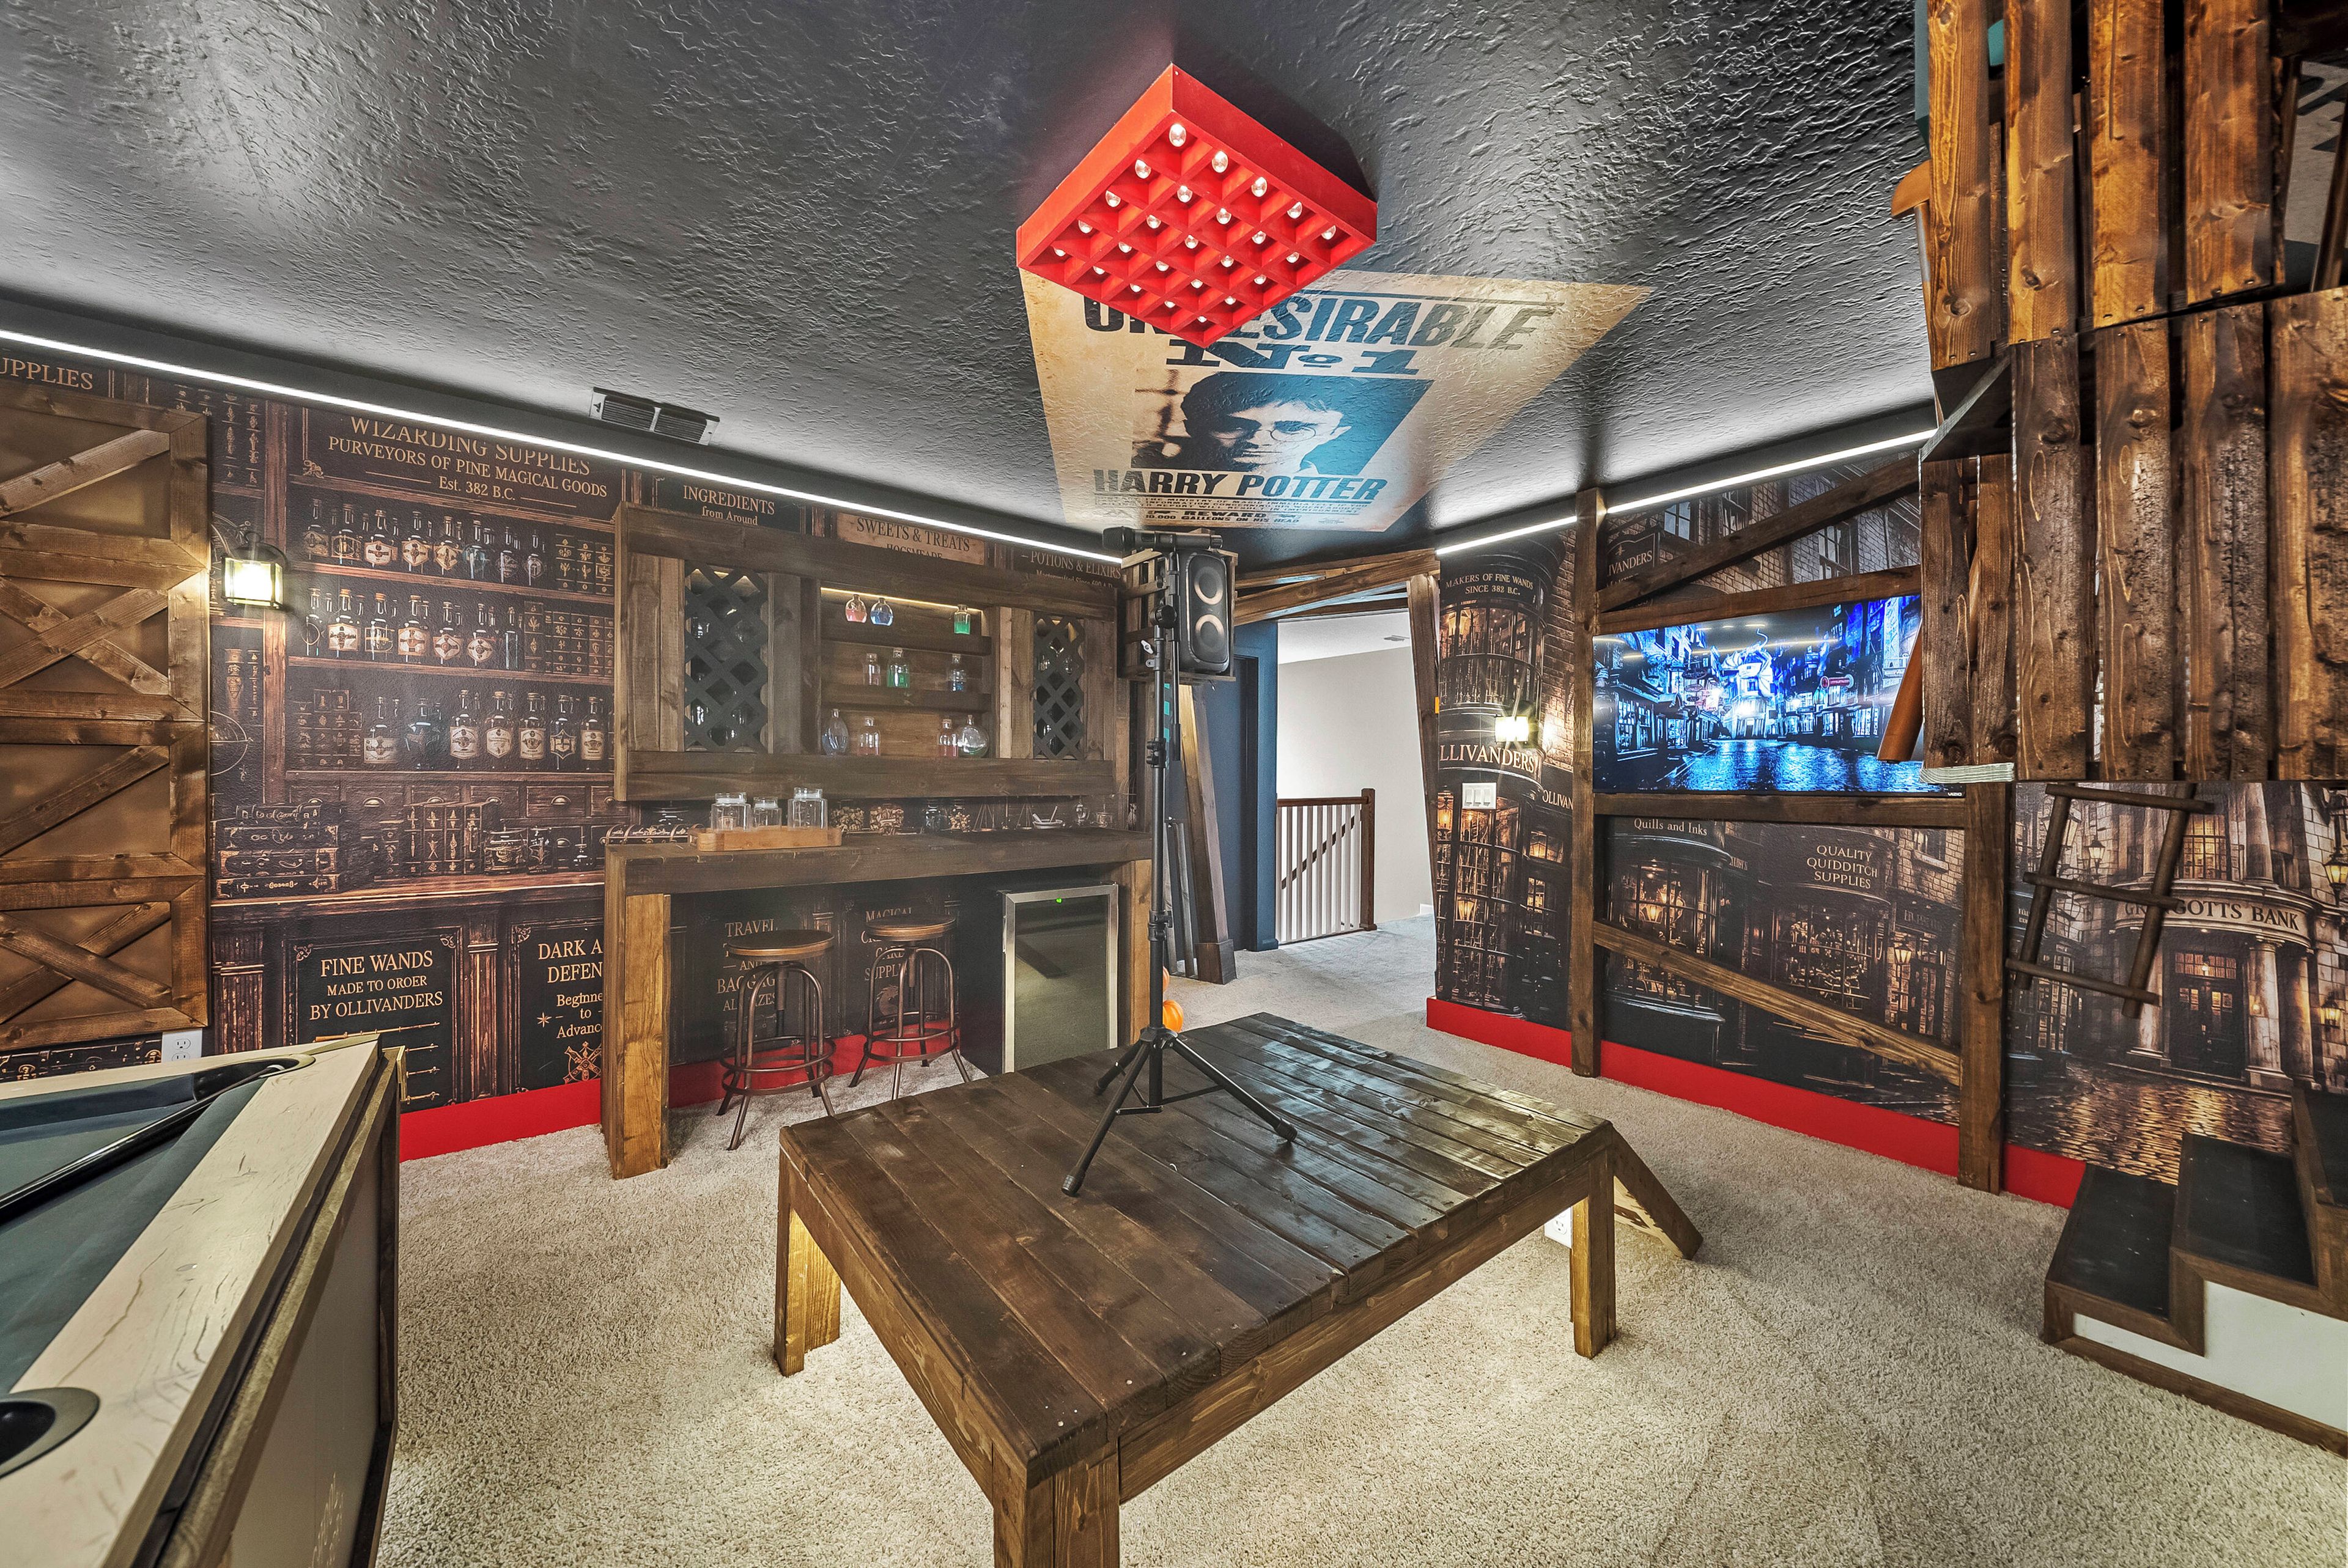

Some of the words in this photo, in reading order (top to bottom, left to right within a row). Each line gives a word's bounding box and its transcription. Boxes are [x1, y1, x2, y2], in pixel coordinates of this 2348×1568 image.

[1084, 295, 1556, 351] USIRABLE
[1351, 350, 1419, 375] 1
[351, 416, 487, 456] WIZARDING
[495, 444, 591, 476] SUPPLIES
[328, 436, 426, 466] PURVEYORS
[431, 455, 451, 470] OF
[495, 466, 558, 490] MAGICAL
[562, 479, 607, 498] GOODS
[439, 476, 461, 491] Est.
[466, 481, 489, 496] 382
[493, 486, 515, 501] B.C.
[1093, 469, 1228, 495] HARRY
[1236, 474, 1387, 500] POTTER
[683, 485, 775, 515] INGREDIENTS
[702, 506, 723, 520] from
[726, 510, 758, 526] Around
[857, 517, 909, 540] SWEETS
[913, 528, 921, 543] &
[925, 530, 970, 551] TREATS
[1030, 551, 1074, 570] POTIONS
[1076, 561, 1084, 572] &
[1086, 563, 1121, 579] ELIXIRS
[1445, 574, 1480, 588] MAKERS
[1495, 573, 1510, 583] FINE
[1512, 576, 1534, 590] WANDS
[1465, 585, 1489, 594] SINCE
[1508, 587, 1521, 595] B.C.
[1634, 818, 1664, 830] Quills
[1667, 822, 1685, 832] and
[1688, 822, 1707, 836] Inks
[1817, 845, 1872, 862] QUALITY
[1807, 857, 1878, 878] QUIDDITCH
[1814, 871, 1871, 889] SUPPLIES
[2125, 900, 2242, 919] GRGOTTS
[2251, 905, 2299, 930] BANK
[725, 919, 778, 937] TRAVEL
[538, 940, 586, 960] DARK
[321, 956, 365, 977] FINE
[369, 950, 433, 972] WANDS
[327, 982, 363, 996] MADE
[367, 980, 383, 992] TO
[309, 1004, 331, 1020] BY
[336, 991, 443, 1017] OLLIVANDERS
[580, 1009, 591, 1019] to
[556, 1023, 602, 1039] Advanc
